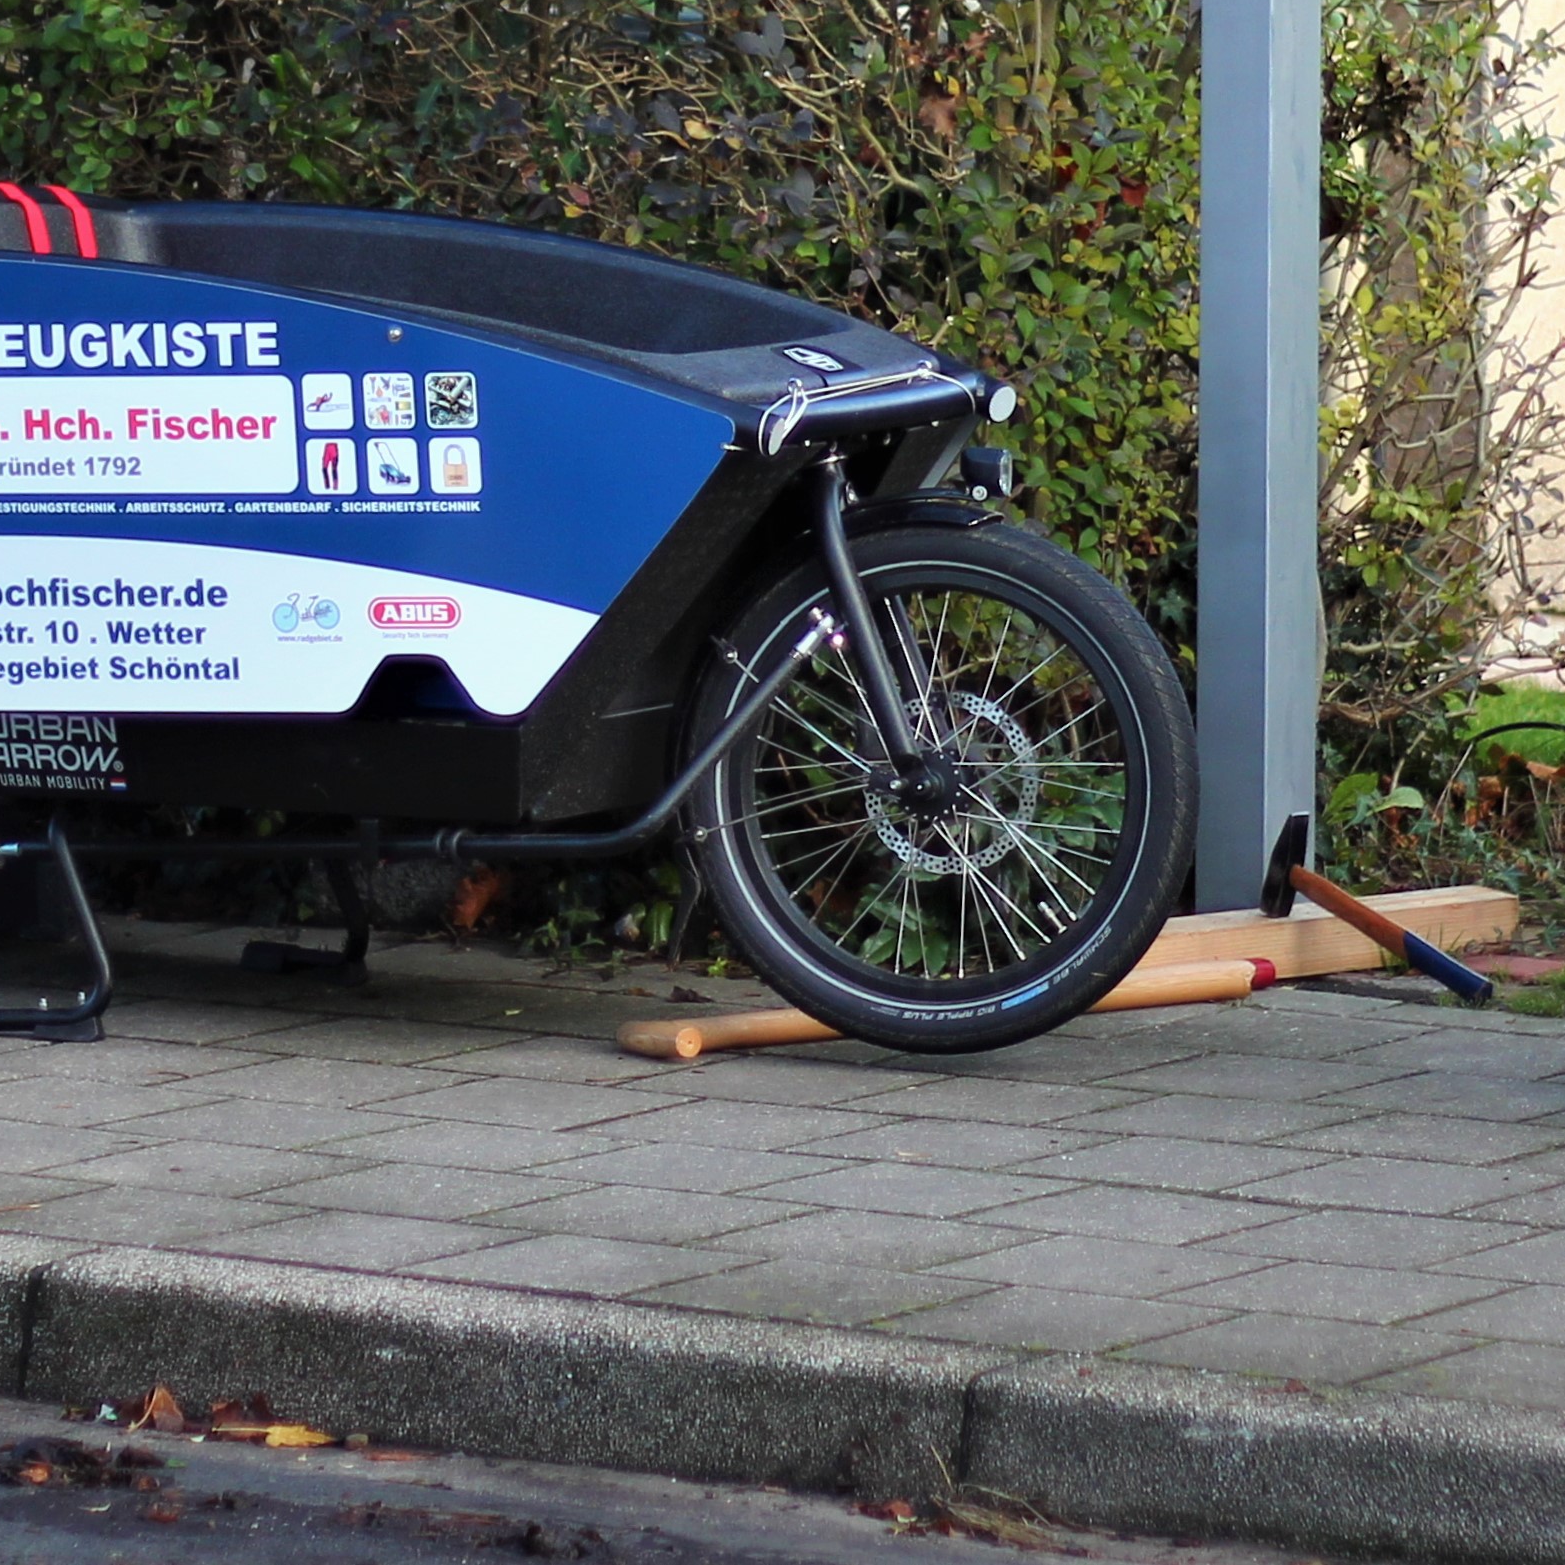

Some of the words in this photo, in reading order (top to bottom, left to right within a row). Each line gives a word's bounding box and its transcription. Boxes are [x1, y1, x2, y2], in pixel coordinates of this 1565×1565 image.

[24, 409, 113, 440] Hch.
[127, 408, 277, 439] Fischer
[84, 457, 141, 476] 1792
[125, 502, 226, 513] ARBEITSSCHUTZ
[235, 502, 331, 513] GARTENBEDARF
[341, 501, 481, 513] SICHERHEITSTECHNIK
[381, 604, 449, 621] ABUS
[44, 621, 79, 644] 10
[106, 621, 206, 644] Wetter
[109, 656, 240, 680] Schöntal
[0, 773, 41, 788] URBAN
[47, 776, 105, 790] MOBILITY
